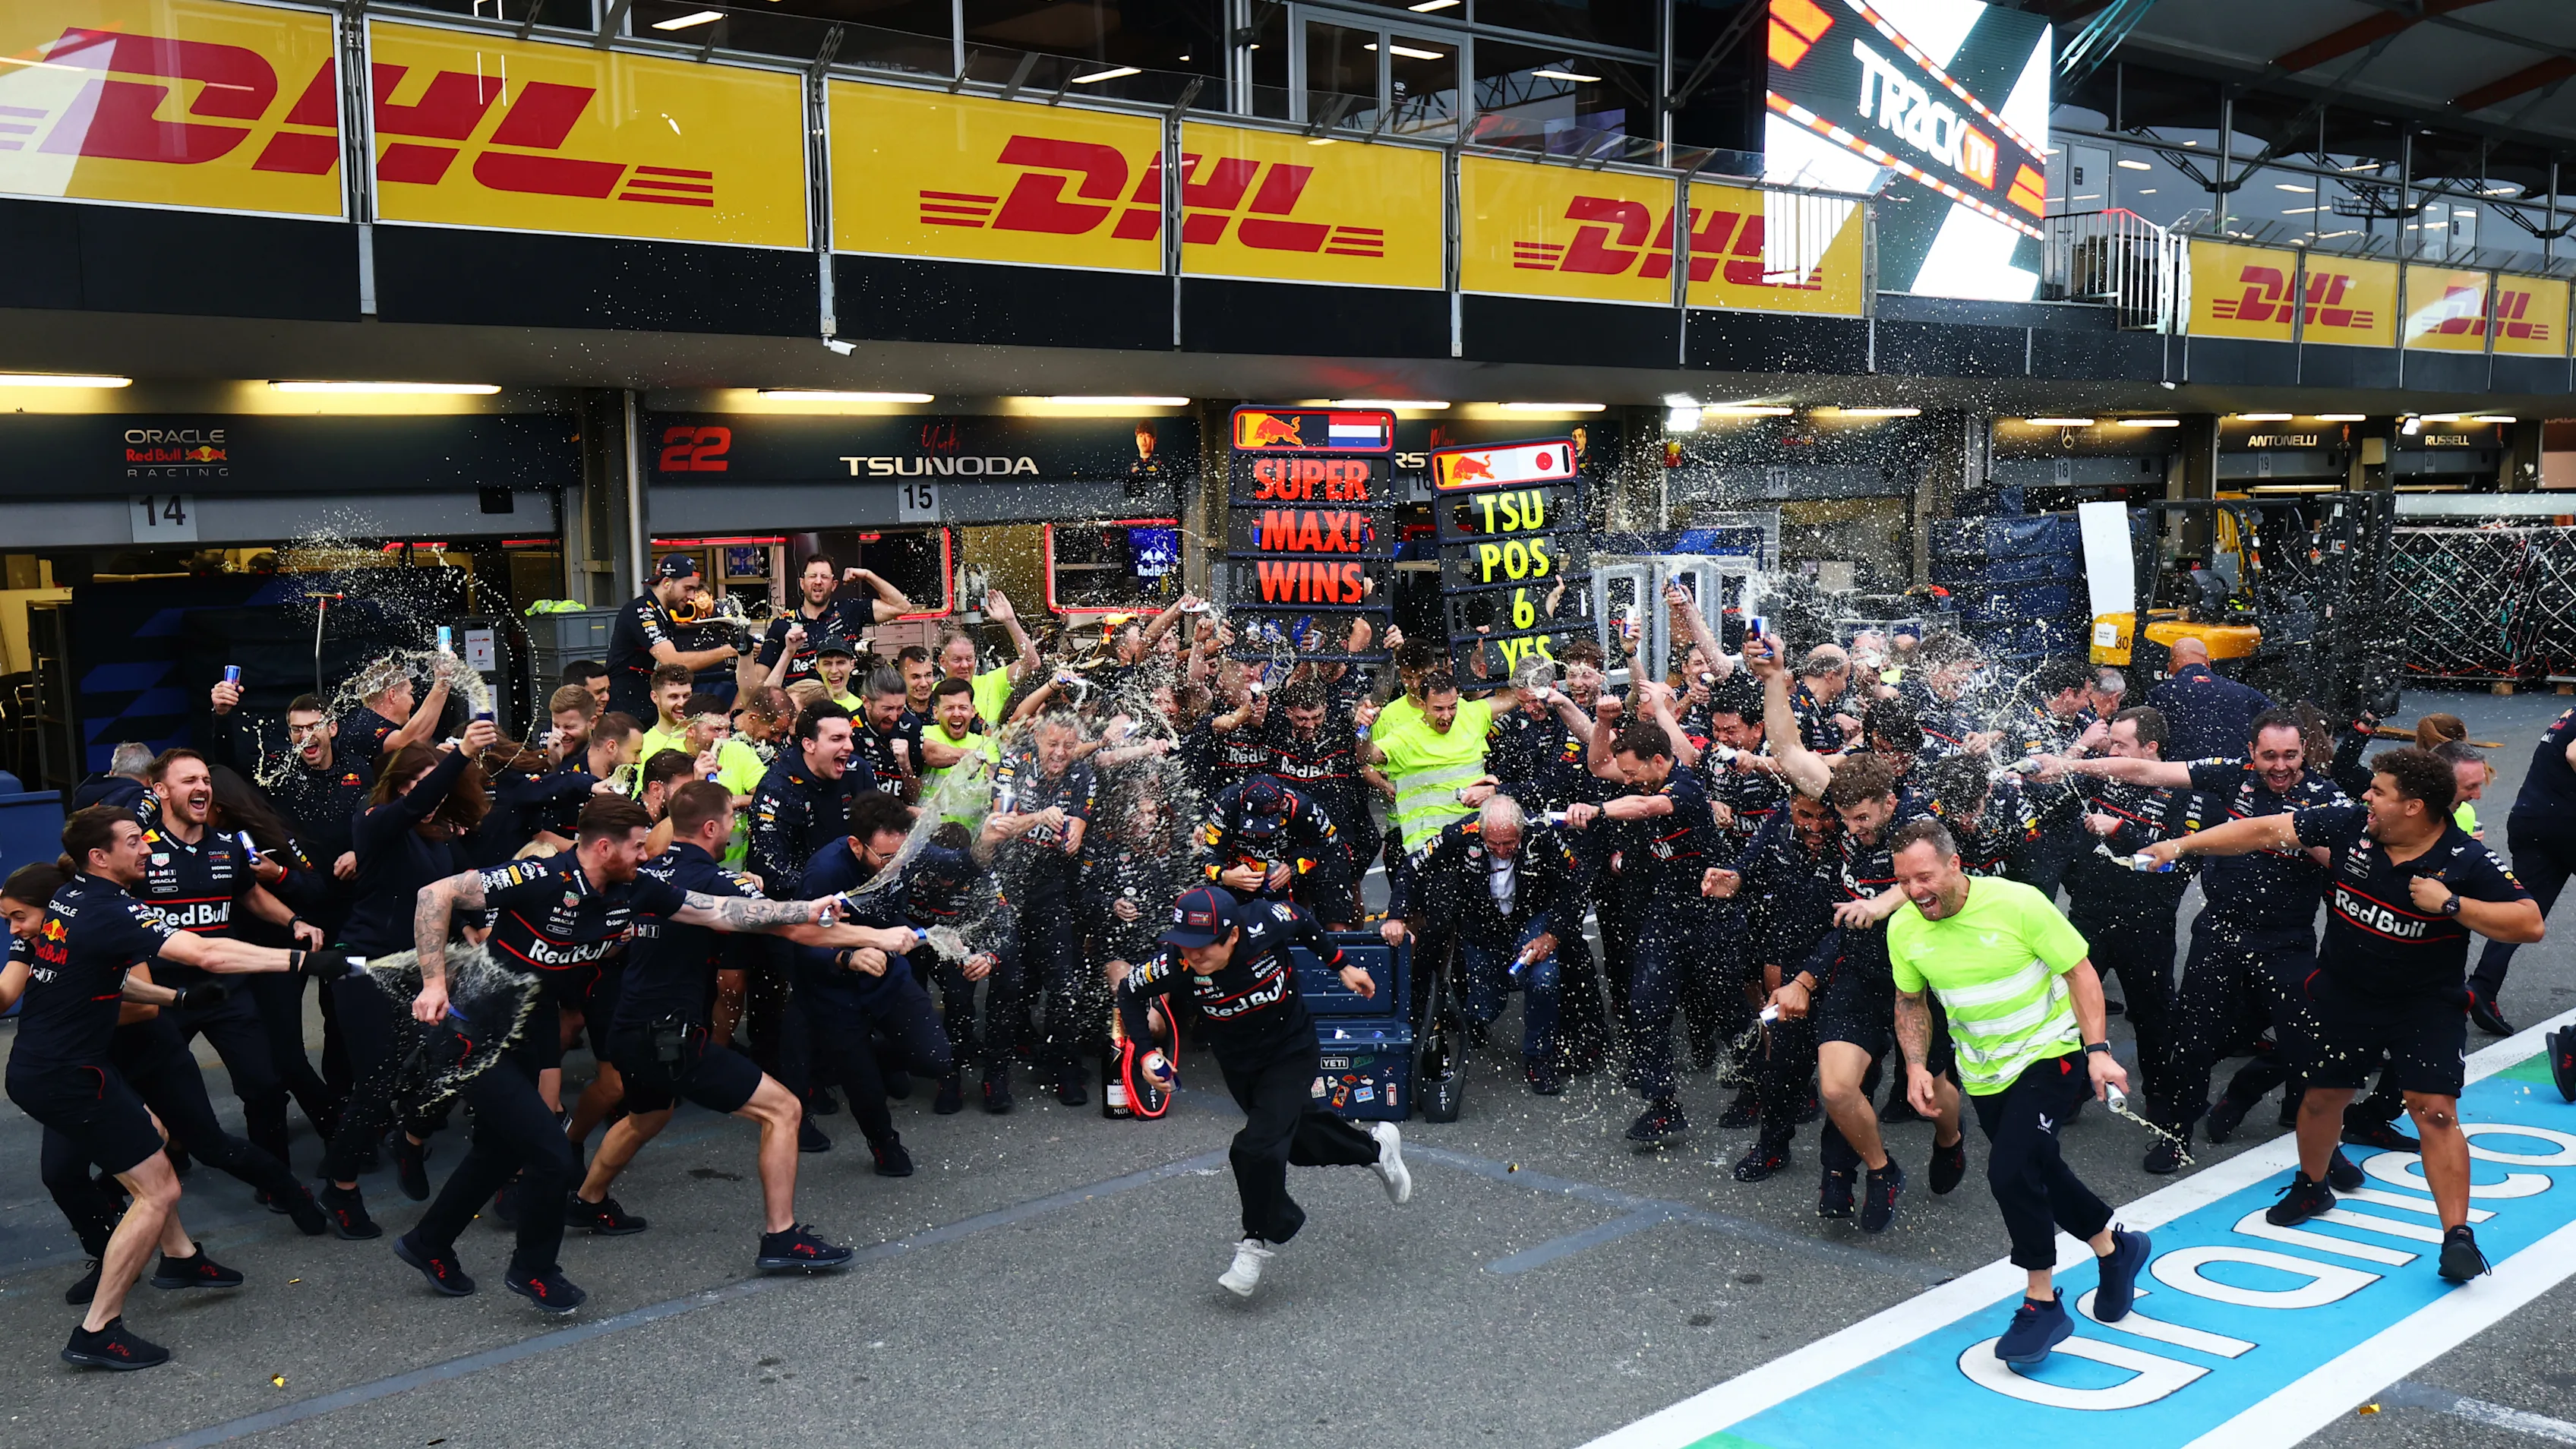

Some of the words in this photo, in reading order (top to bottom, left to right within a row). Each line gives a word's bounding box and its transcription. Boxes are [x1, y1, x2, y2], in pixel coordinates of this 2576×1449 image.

[38, 27, 627, 199] DHL
[1968, 134, 1994, 178] TV
[992, 135, 1331, 253] DHL
[1559, 196, 1800, 289] DHL
[2235, 265, 2353, 327] DHL
[2439, 286, 2532, 339] DHL
[125, 429, 226, 444] ORACLE
[659, 427, 731, 471] 22
[2247, 434, 2318, 447] ANTONELLI
[2425, 434, 2470, 447] RUSSELL
[125, 448, 153, 462] Red
[155, 448, 182, 462] Bull
[839, 456, 1040, 476] TSUNODA
[2259, 456, 2269, 471] 19
[127, 468, 229, 477] RACING
[1253, 458, 1369, 501] SUPER
[1413, 472, 1432, 491] 16
[2057, 462, 2069, 478] 18
[904, 484, 933, 509] 15
[139, 494, 186, 526] 14
[1476, 489, 1545, 533] TSU
[1260, 510, 1362, 553] MAX!
[1478, 538, 1550, 583] POS
[1257, 560, 1363, 604] WINS
[1512, 587, 1536, 630] 6
[2115, 635, 2129, 650] 30
[1280, 755, 1308, 778] Red
[2347, 855, 2371, 870] ORACLE
[2348, 847, 2367, 860] Mobil
[49, 899, 78, 918] ORACLE
[153, 904, 195, 927] Red
[198, 901, 230, 924] Bull
[549, 916, 575, 926] ORACLE
[2334, 888, 2379, 925] Red
[2376, 909, 2427, 938] Bull
[529, 938, 573, 964] Red
[571, 939, 613, 963] Bull
[1194, 987, 1214, 996] Mobil
[1202, 996, 1249, 1018] Red
[1249, 971, 1285, 1006] Bull
[1322, 1059, 1346, 1067] YETI
[1957, 1122, 2576, 1411] aramco
